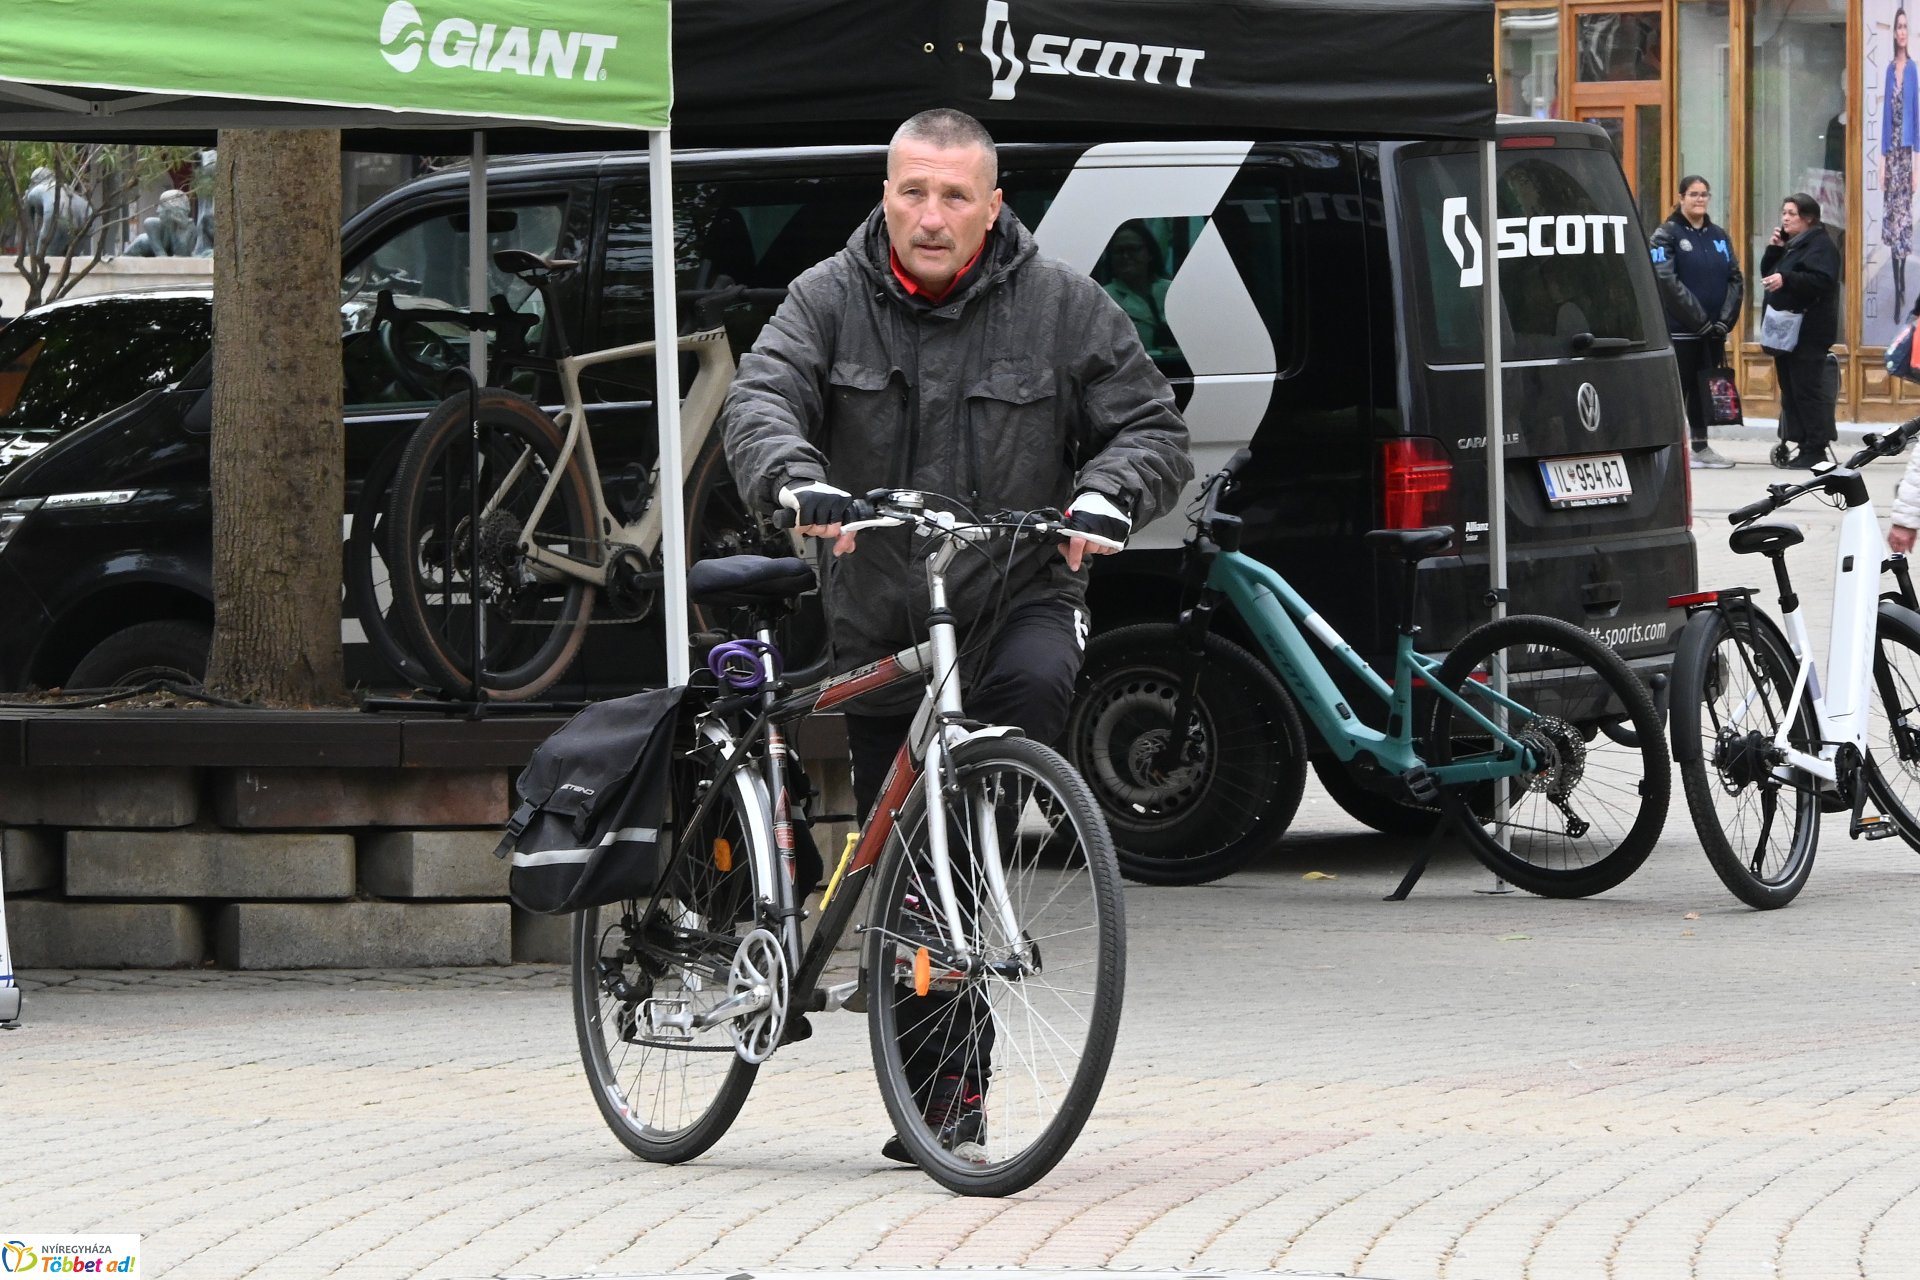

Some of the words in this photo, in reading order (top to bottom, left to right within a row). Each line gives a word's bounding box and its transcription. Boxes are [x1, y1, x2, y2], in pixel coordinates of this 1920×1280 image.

[428, 17, 619, 82] GIANT
[1027, 33, 1206, 88] SCOTT
[1866, 23, 1879, 191] BARCLAY
[1497, 214, 1628, 259] SCOTT
[1866, 210, 1878, 318] BETTY
[1457, 433, 1519, 450] CARALLE
[1575, 462, 1605, 491] 954
